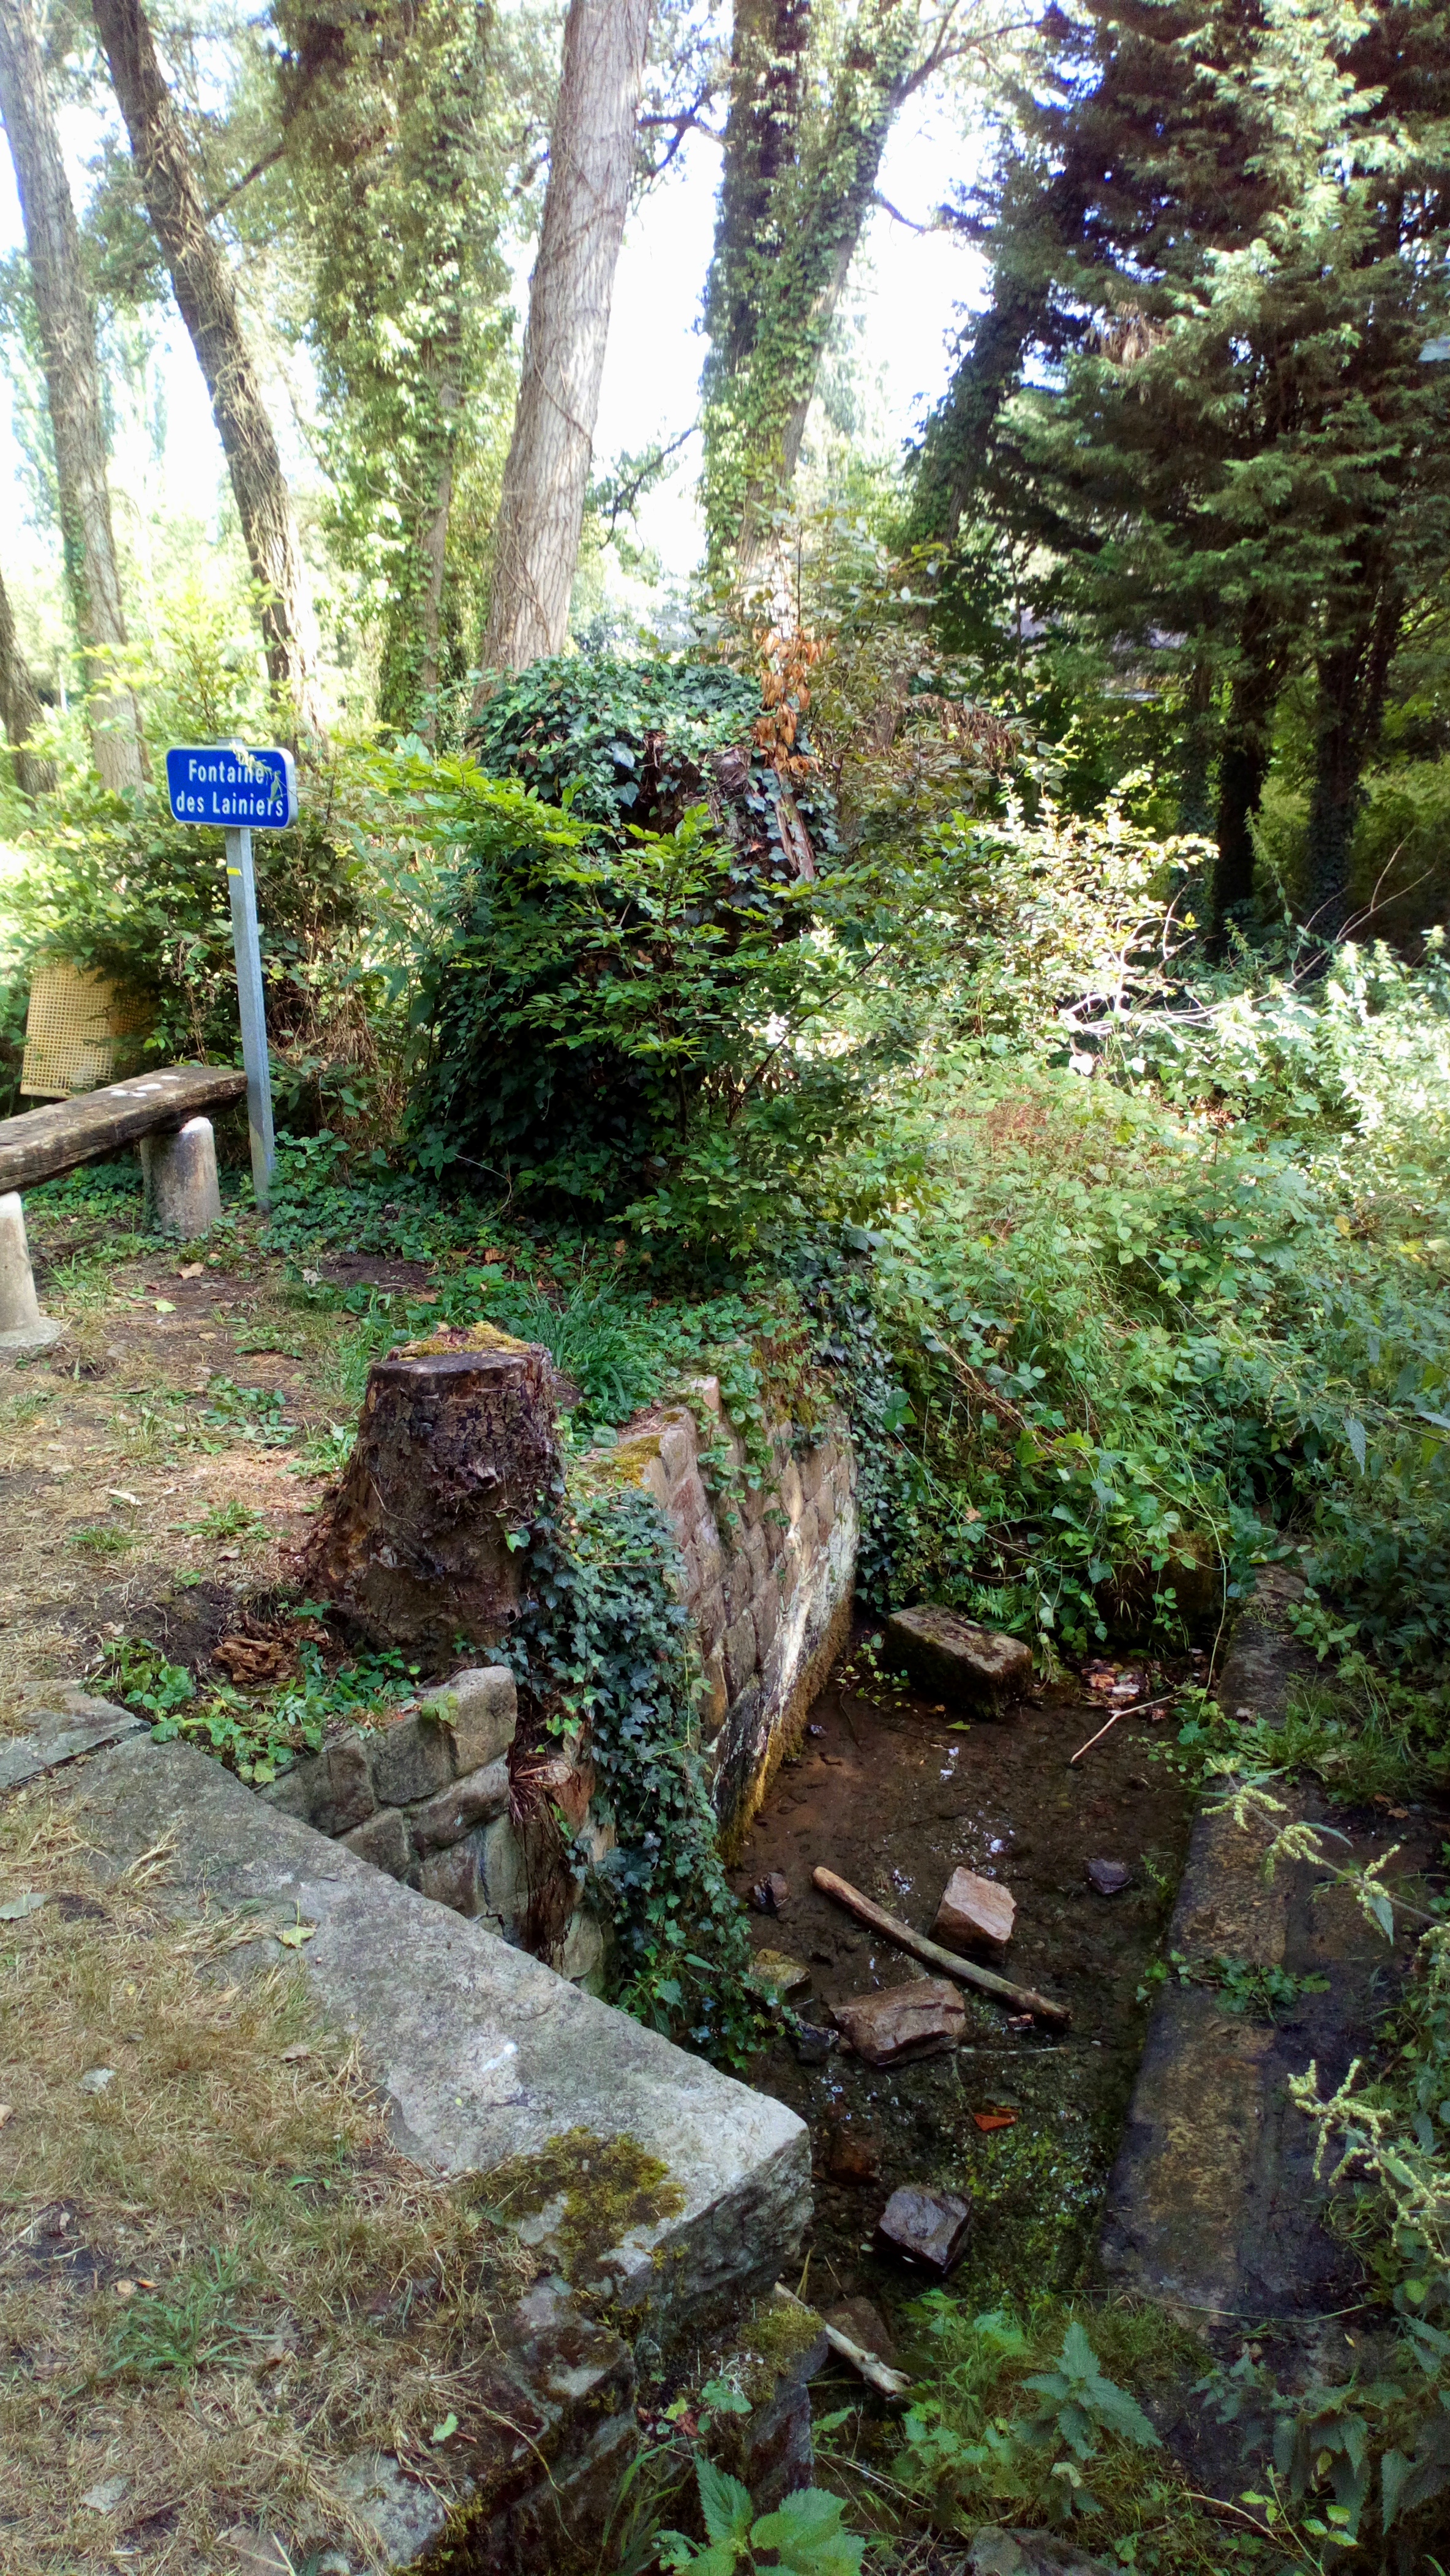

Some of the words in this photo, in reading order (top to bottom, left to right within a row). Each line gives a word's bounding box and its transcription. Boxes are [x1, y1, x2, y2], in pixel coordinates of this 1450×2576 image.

[188, 759, 265, 784] Fontaine
[176, 790, 205, 813] des
[212, 792, 284, 817] Lainiers
